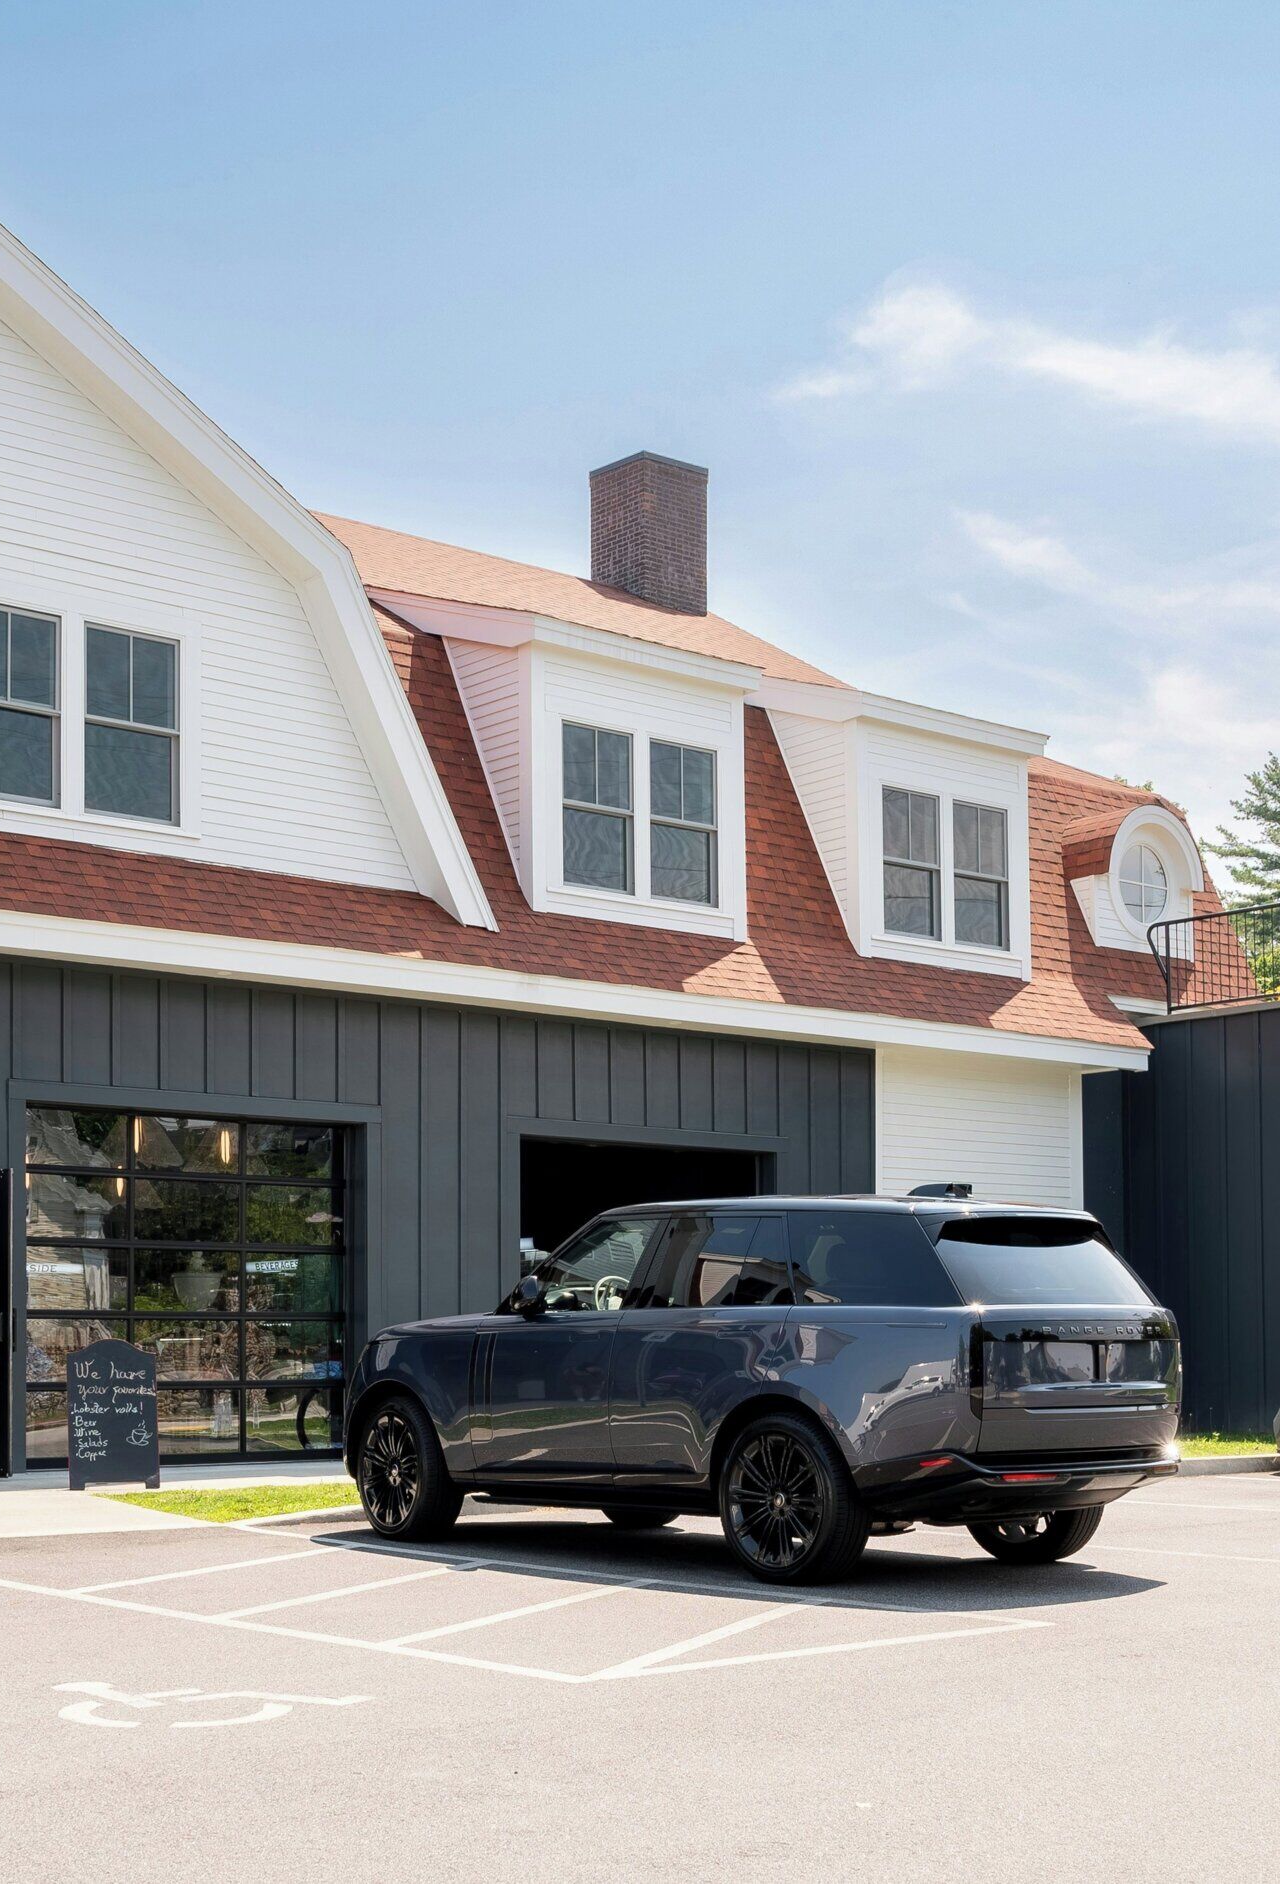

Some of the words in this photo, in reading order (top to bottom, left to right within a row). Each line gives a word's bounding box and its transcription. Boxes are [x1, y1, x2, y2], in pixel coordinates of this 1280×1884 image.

[254, 1260, 299, 1271] BEVERAGES
[1041, 1326, 1105, 1335] RANGE
[1114, 1325, 1162, 1335] ROVER
[73, 1359, 101, 1380] We
[109, 1361, 146, 1380] have
[77, 1384, 109, 1401] your
